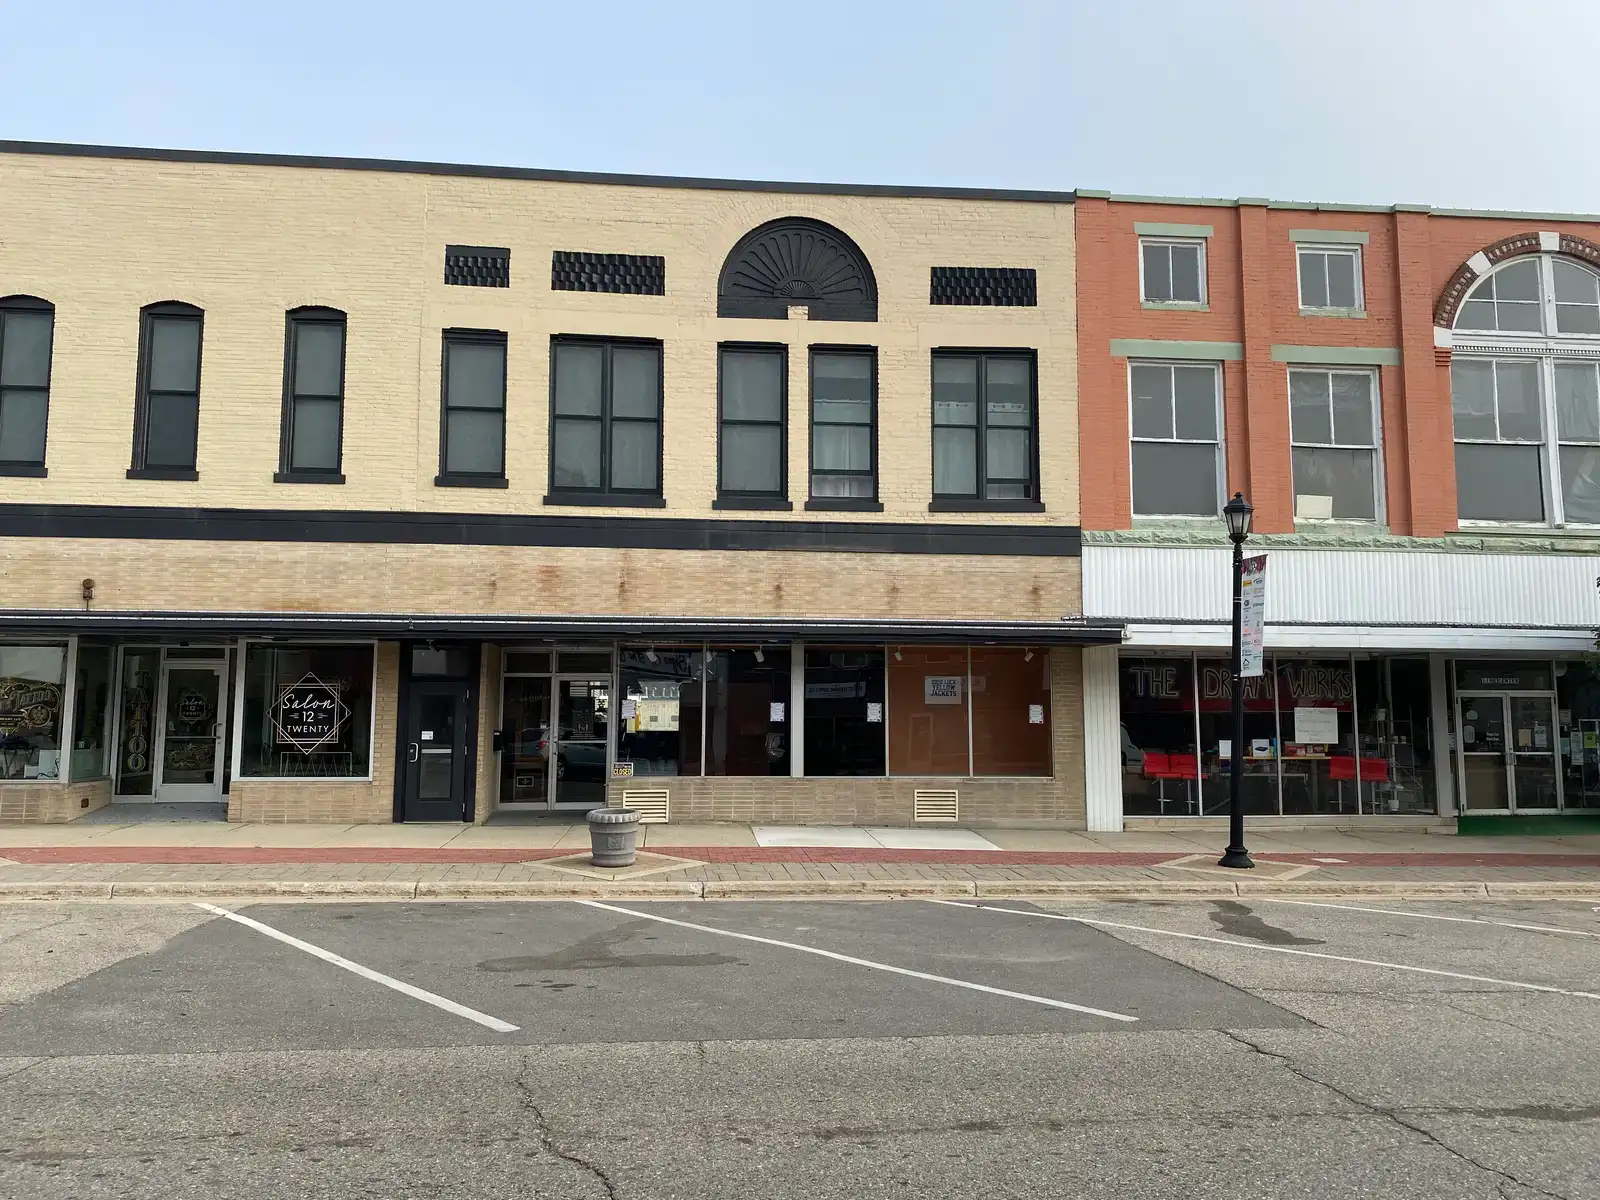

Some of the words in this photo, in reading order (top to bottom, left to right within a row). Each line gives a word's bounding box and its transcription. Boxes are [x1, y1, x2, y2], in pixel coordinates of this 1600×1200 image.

[1129, 667, 1179, 697] THE
[1203, 667, 1273, 698] DRAM
[1287, 667, 1352, 698] WORKS
[180, 696, 205, 706] Salon
[282, 693, 335, 709] Salon
[128, 670, 149, 772] TATTOO
[302, 711, 315, 722] 12
[286, 725, 330, 733] TWENTY
[613, 768, 632, 776] CLOSED
